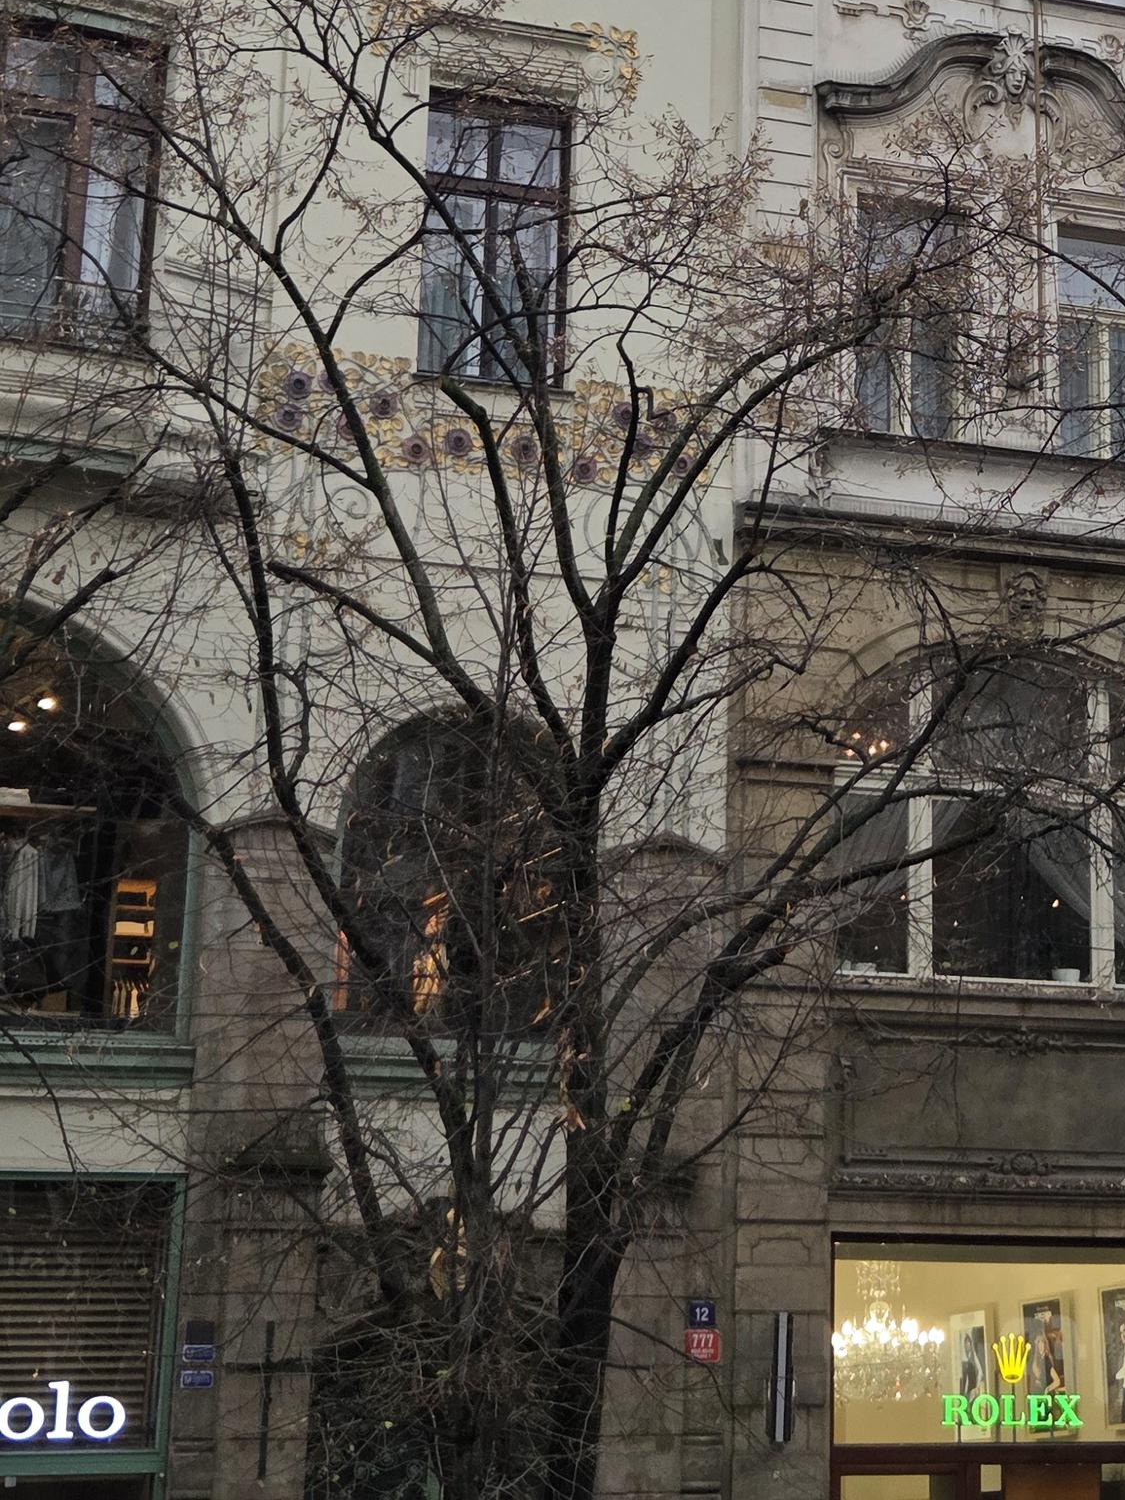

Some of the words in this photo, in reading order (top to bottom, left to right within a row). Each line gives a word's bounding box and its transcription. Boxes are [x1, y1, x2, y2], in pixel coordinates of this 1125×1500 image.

[695, 1307, 709, 1321] 12
[692, 1333, 714, 1348] 777
[0, 1381, 126, 1440] olo
[942, 1394, 1084, 1427] ROLEX
